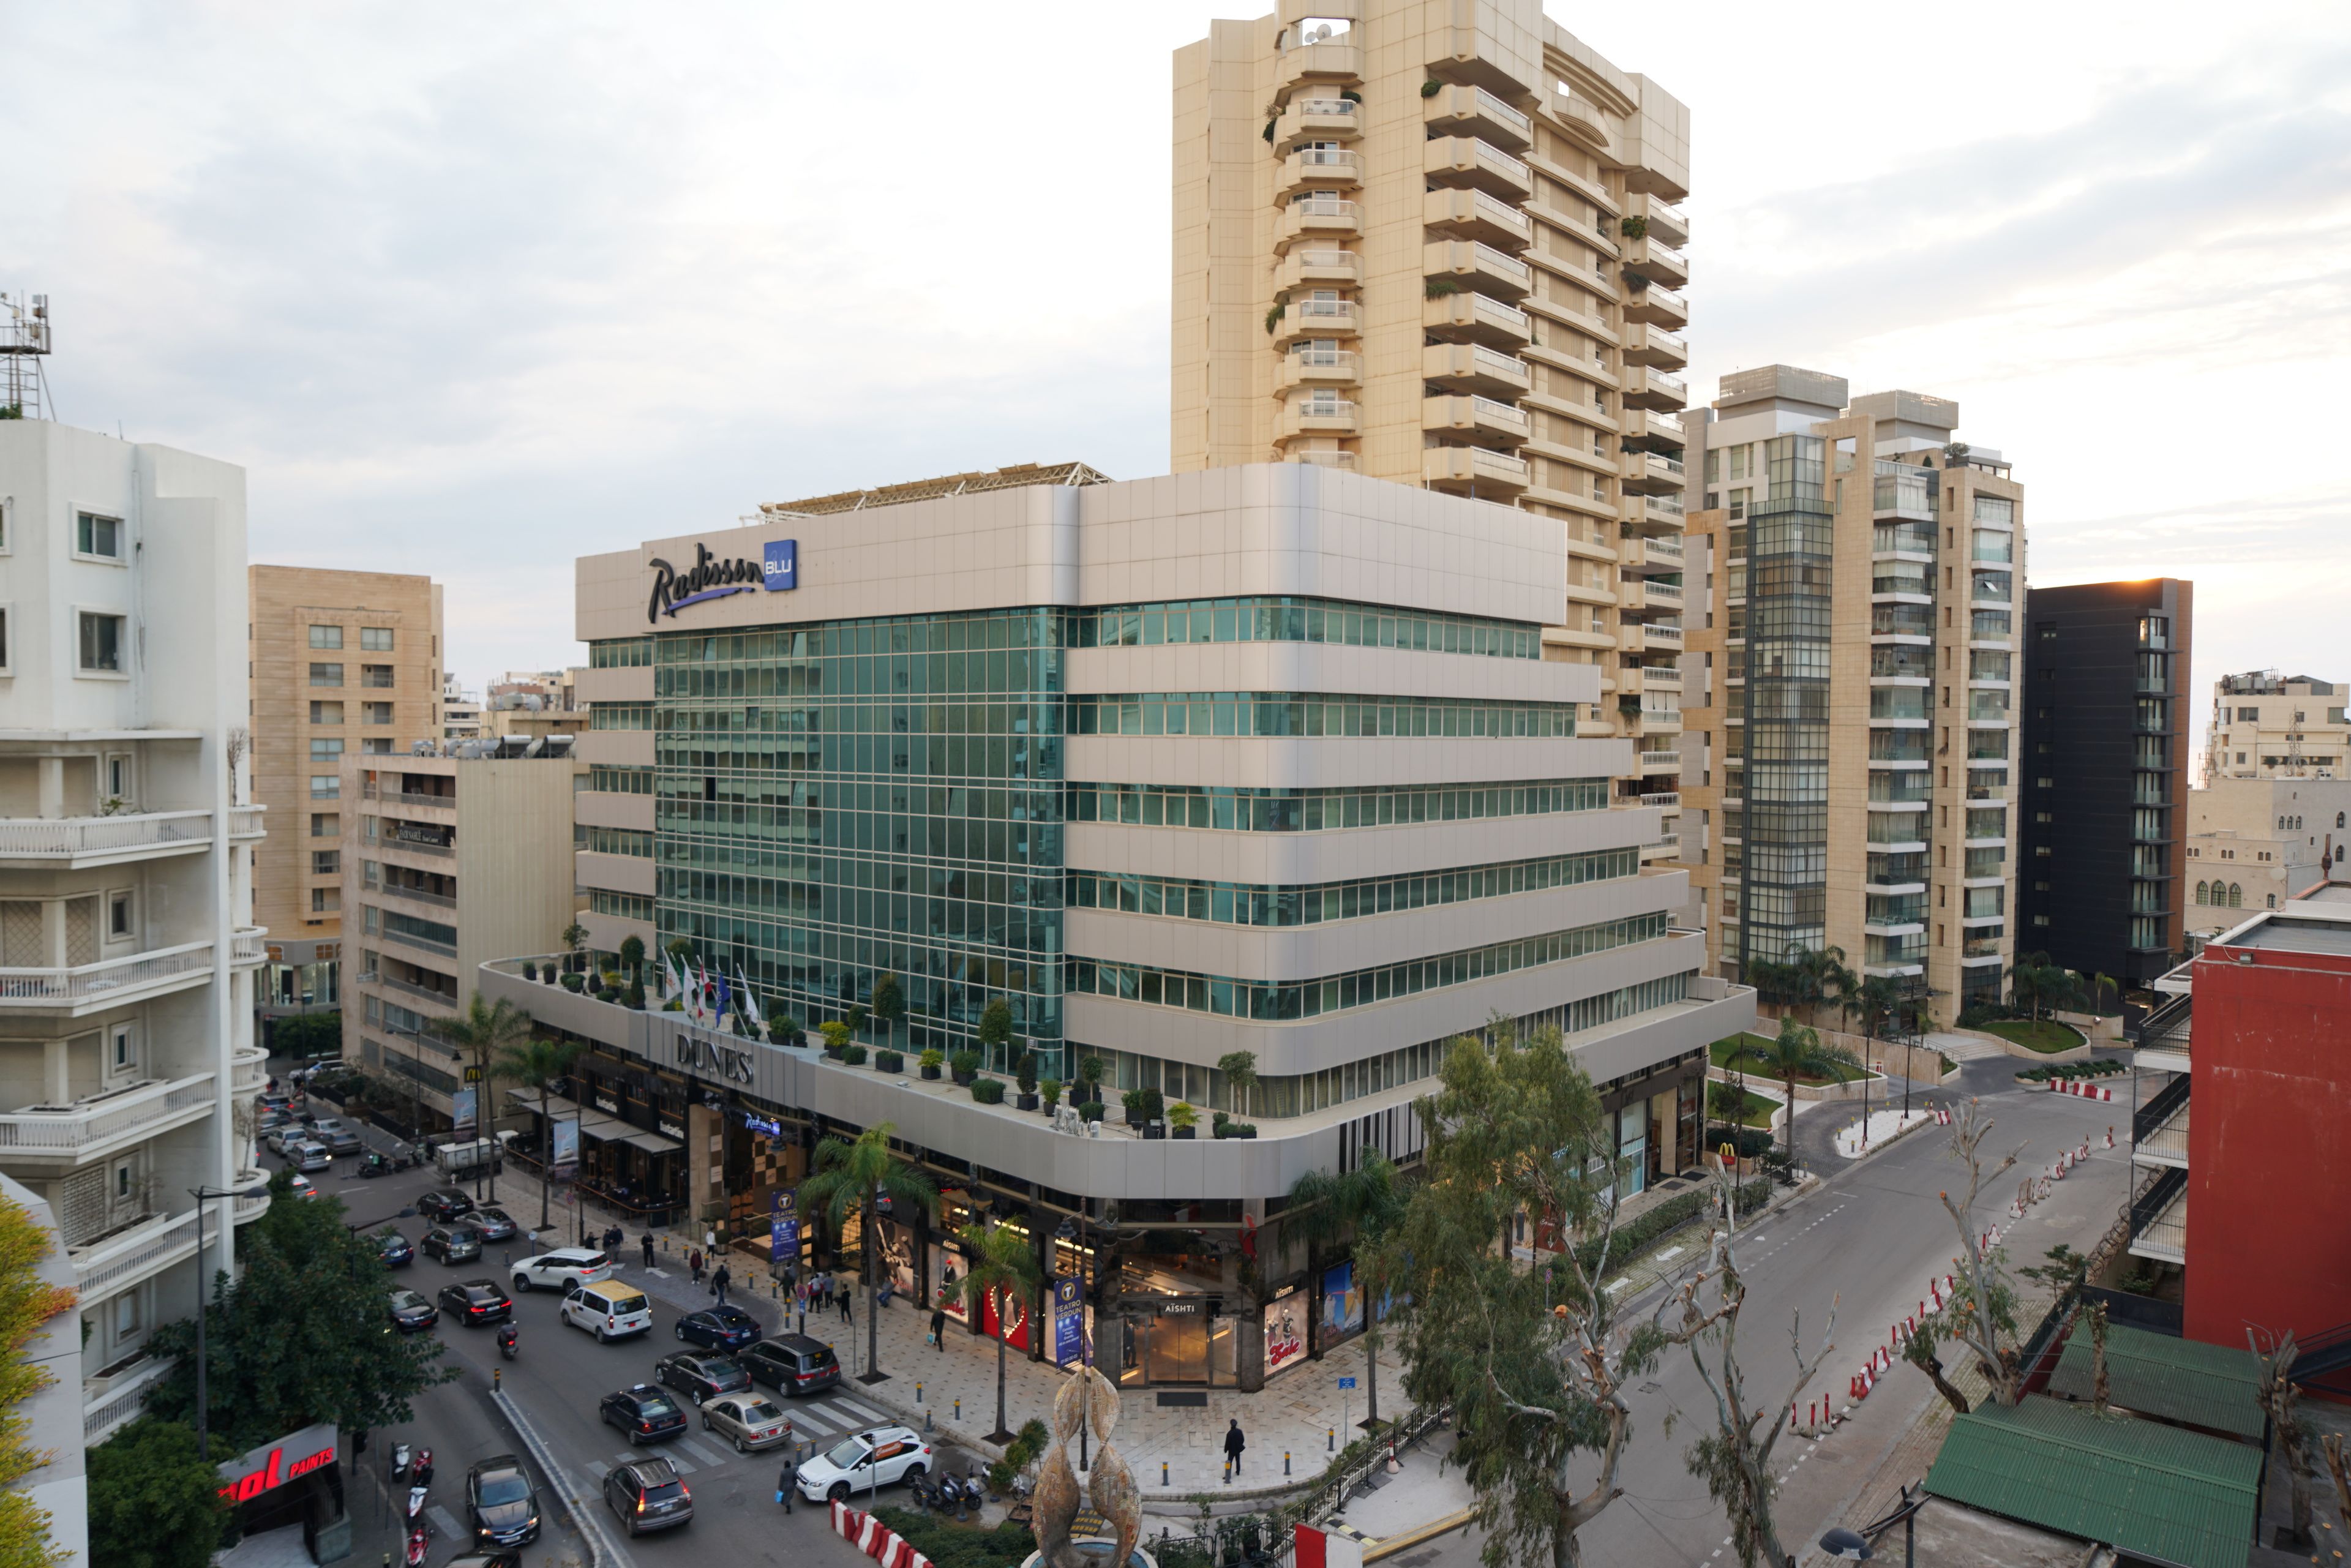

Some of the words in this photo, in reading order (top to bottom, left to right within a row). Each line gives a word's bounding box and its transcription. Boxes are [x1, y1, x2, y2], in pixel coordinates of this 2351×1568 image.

[648, 542, 765, 623] Radisson
[765, 559, 791, 574] BLU
[677, 1032, 753, 1083] DUNES
[772, 1214, 798, 1224] VERDUN
[773, 1208, 798, 1218] TEATRO
[1056, 1299, 1081, 1313] TEATRO
[1164, 1303, 1194, 1313] AÏSHTI
[1056, 1307, 1081, 1320] VERDUN
[1270, 1336, 1300, 1366] Sale
[290, 1447, 334, 1479] PAINTS
